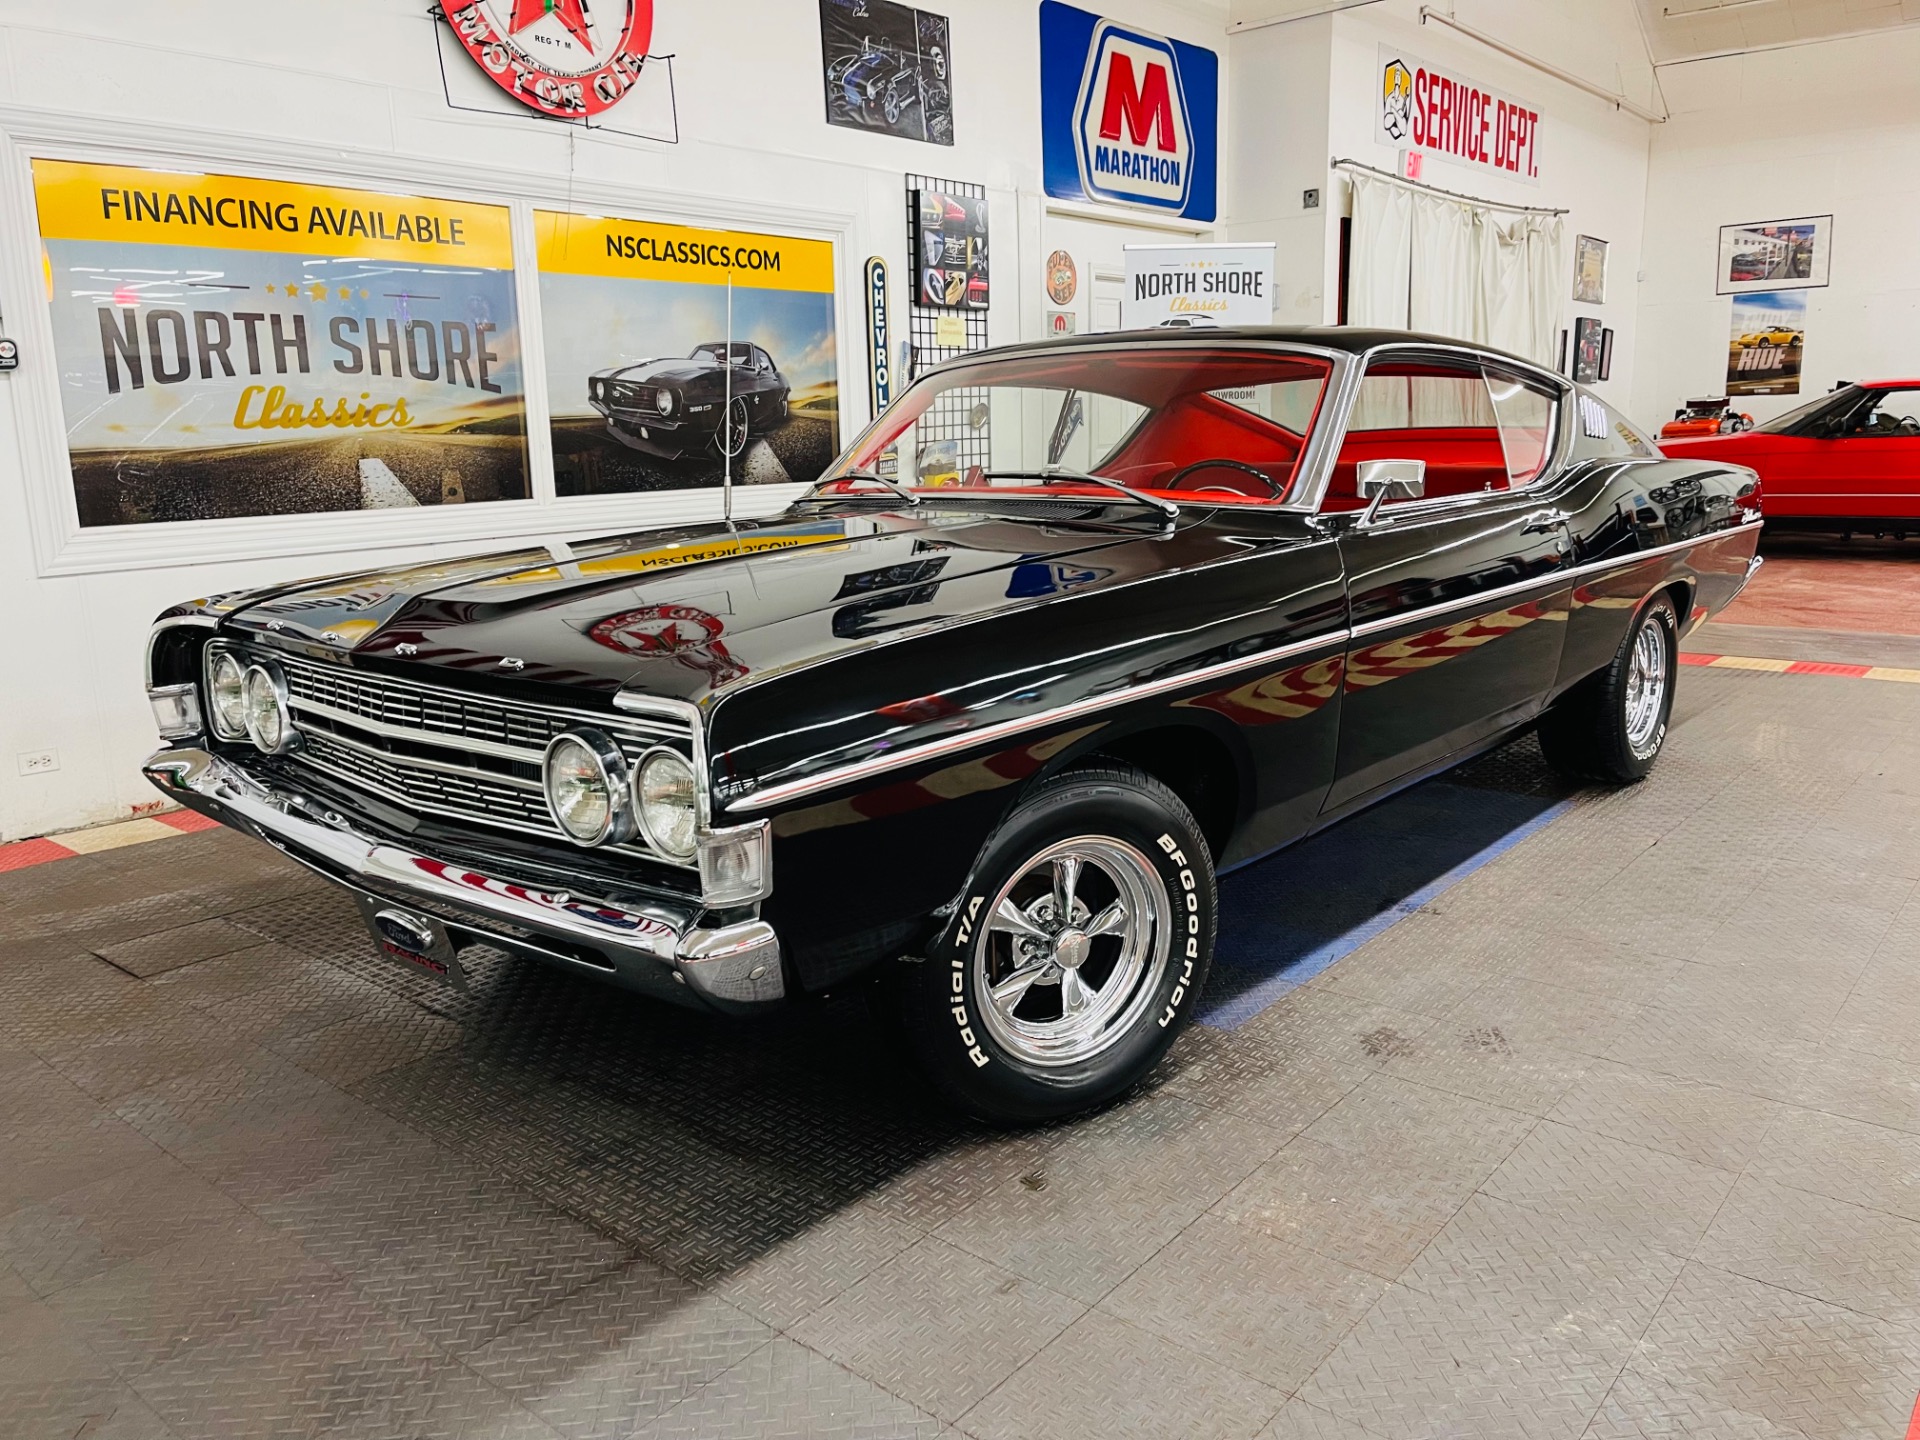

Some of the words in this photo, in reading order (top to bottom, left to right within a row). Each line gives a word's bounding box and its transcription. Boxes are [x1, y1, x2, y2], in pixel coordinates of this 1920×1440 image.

[452, 6, 587, 113] MOTOR
[534, 34, 552, 45] REG
[555, 39, 560, 47] T
[564, 41, 572, 49] M
[1099, 51, 1176, 153] M
[1413, 67, 1491, 164] SERVICE
[1494, 98, 1539, 178] DEPT.
[1095, 144, 1180, 187] MARATHON
[101, 188, 299, 233] FINANCING
[307, 205, 466, 246] AVAILABLE
[605, 233, 782, 272] NSCLASSICS.COM
[1054, 283, 1073, 302] BEE
[1135, 272, 1196, 301] NORTH
[1203, 271, 1263, 298] SHORE
[1169, 296, 1228, 312] Classics
[98, 306, 309, 395] NORTH
[329, 316, 502, 395] SHORE
[1737, 348, 1786, 371] RIDE
[232, 385, 415, 431] Classics
[387, 922, 412, 944] Ford
[955, 895, 986, 948] T/A
[1156, 832, 1200, 1029] BFGoodrich
[950, 960, 990, 1068] Radial
